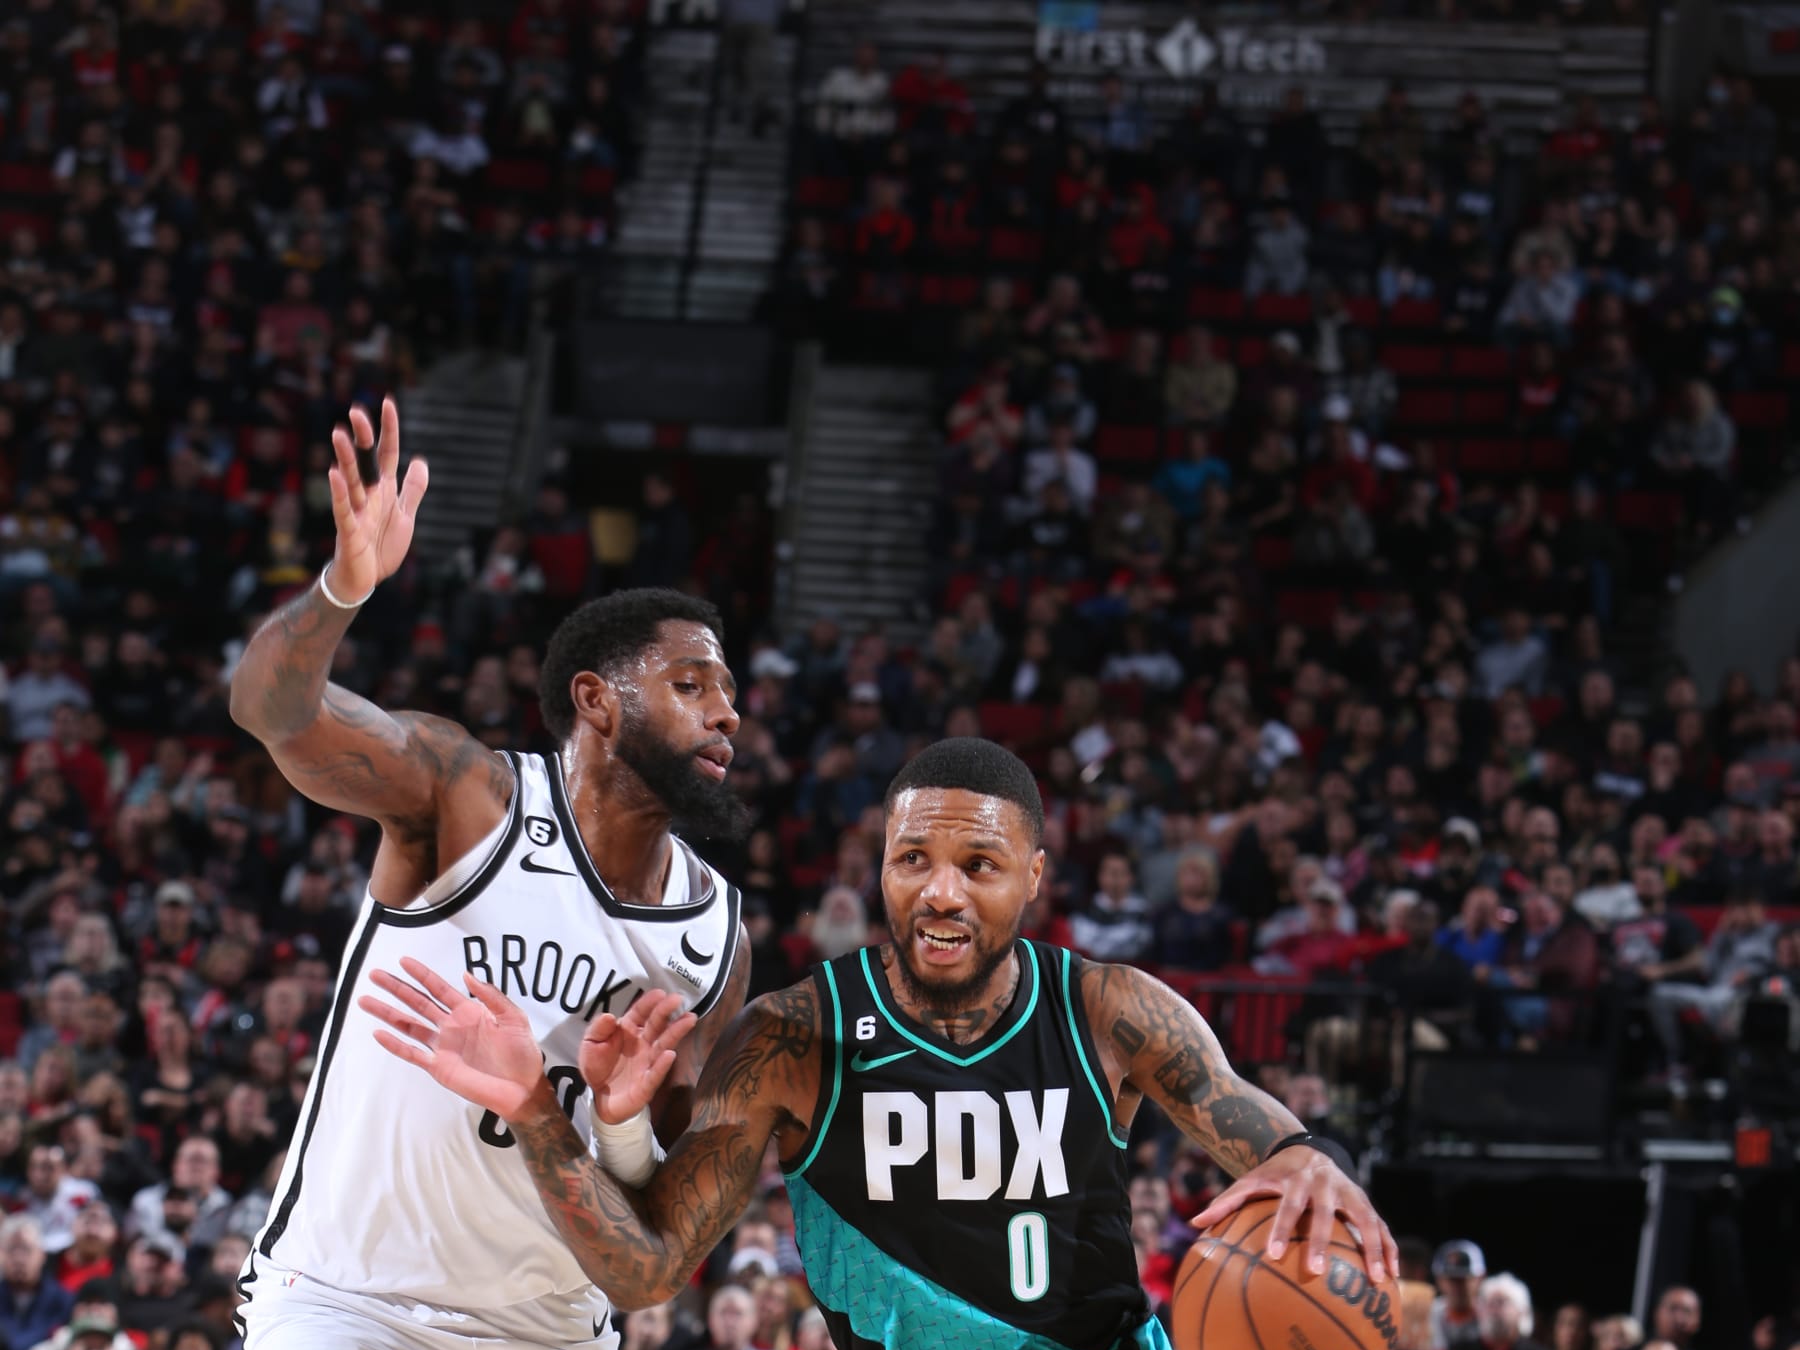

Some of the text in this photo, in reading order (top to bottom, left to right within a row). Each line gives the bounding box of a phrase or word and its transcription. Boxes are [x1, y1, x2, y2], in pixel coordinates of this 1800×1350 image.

[1217, 28, 1327, 72] Tech
[529, 820, 551, 846] 6
[463, 934, 644, 1023] BROOK
[667, 955, 703, 989] Webull
[855, 1015, 876, 1040] 6
[862, 1087, 1070, 1201] PDX
[1007, 1211, 1050, 1302] 0
